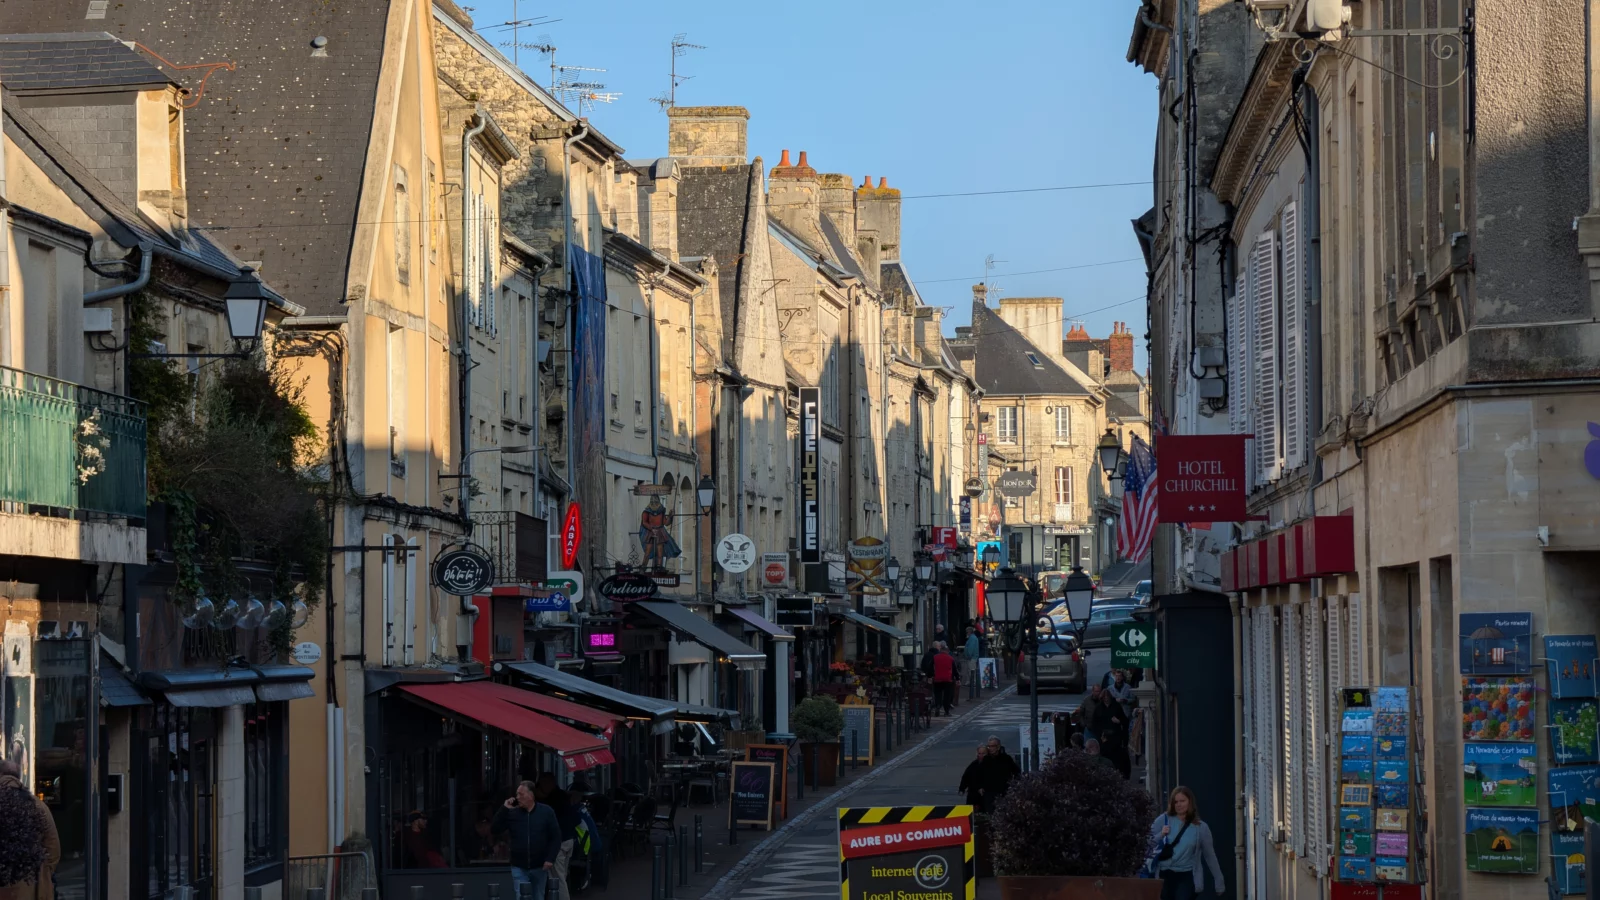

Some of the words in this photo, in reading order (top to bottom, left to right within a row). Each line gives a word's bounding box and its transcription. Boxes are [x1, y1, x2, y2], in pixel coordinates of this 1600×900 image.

[1178, 460, 1225, 475] HOTEL
[1165, 478, 1239, 493] CHURCHILL
[566, 516, 576, 556] TABAC
[941, 528, 953, 543] F
[602, 581, 654, 595] Ordioni
[1115, 649, 1151, 657] Carrefour
[1126, 657, 1140, 666] city
[1467, 746, 1475, 754] La
[1475, 745, 1500, 754] Normandie
[1501, 746, 1515, 754] c'est
[1516, 746, 1529, 754] beau
[850, 838, 882, 849] AURE
[884, 833, 903, 845] DU
[905, 825, 963, 842] COMMUN
[871, 865, 916, 878] internet
[919, 863, 943, 877] café
[863, 890, 895, 900] Local
[897, 889, 953, 900] Souvenirs
